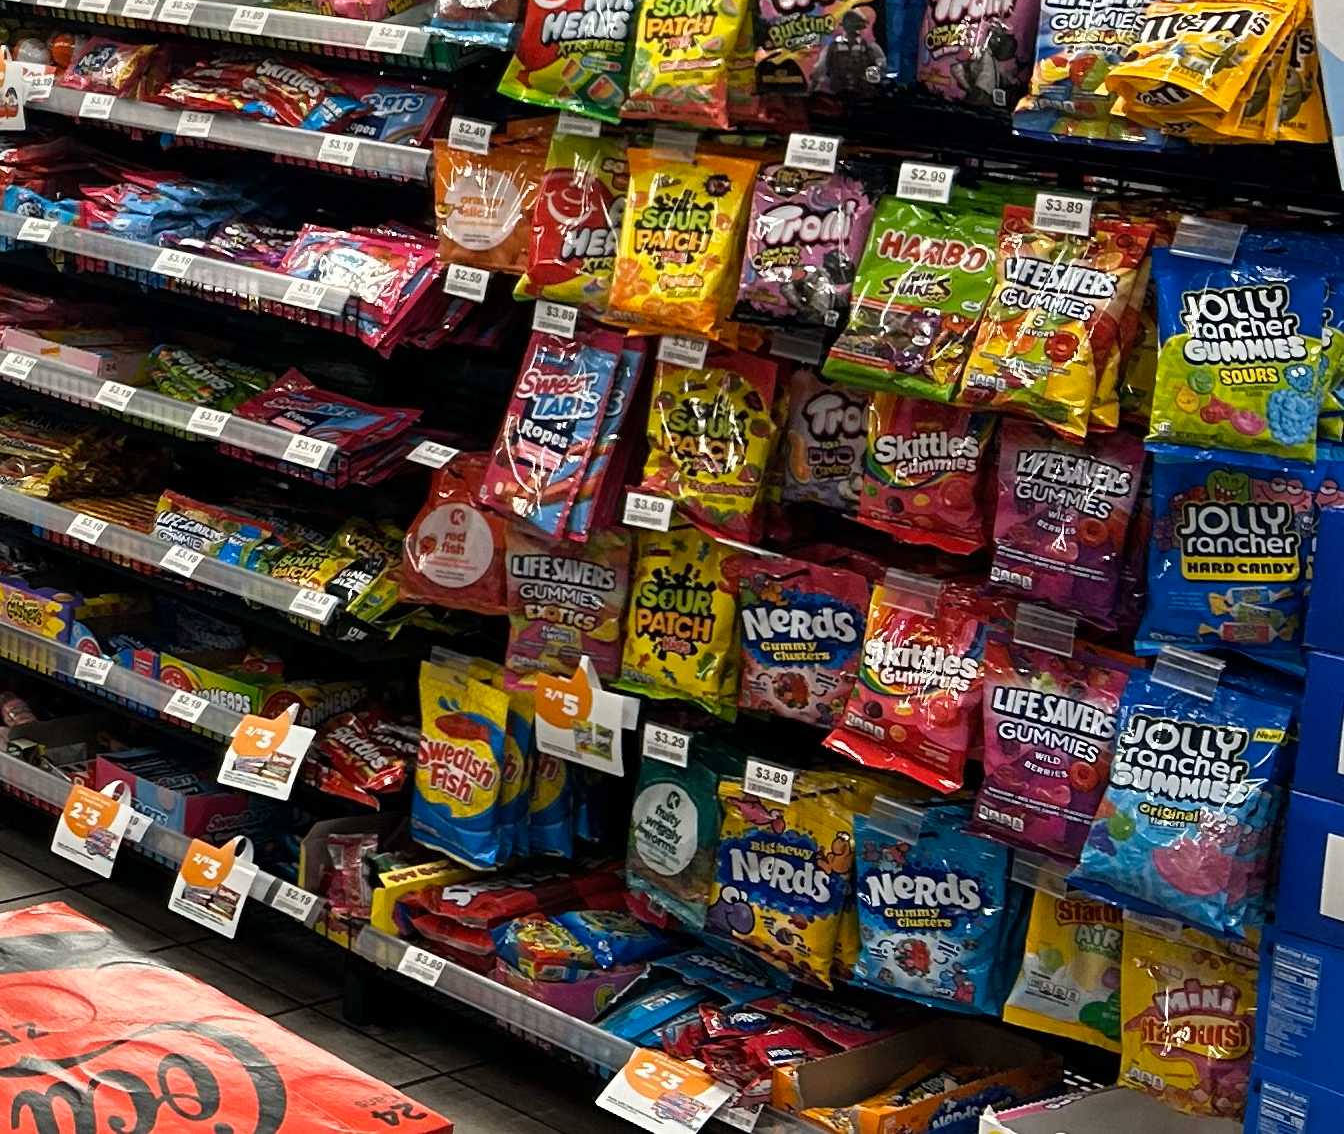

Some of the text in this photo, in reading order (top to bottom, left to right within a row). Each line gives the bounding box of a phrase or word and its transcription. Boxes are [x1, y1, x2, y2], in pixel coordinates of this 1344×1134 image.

[541, 11, 630, 44] HEADS
[645, 16, 718, 40] PATCH
[800, 137, 835, 153] $2.89
[910, 168, 947, 183] $2.99
[1045, 197, 1084, 214] $3.89
[642, 207, 711, 232] SOUR
[758, 200, 859, 244] Trolli
[635, 230, 712, 255] PATCH
[879, 230, 989, 272] HARIBO
[1000, 287, 1094, 321] GUMMIES
[1183, 286, 1287, 320] JOLLY
[1186, 316, 1297, 339] rancher
[1184, 335, 1307, 362] GUMMIES
[1220, 367, 1279, 385] SOURS
[521, 418, 569, 449] Ropes
[874, 433, 980, 464] Skittles
[896, 455, 977, 478] Gummies
[633, 497, 665, 513] $3.69
[1015, 482, 1113, 518] GUMMIES
[1181, 502, 1287, 535] JOLLY
[440, 541, 466, 556] fish
[444, 531, 467, 543] red
[1186, 530, 1298, 556] rancher
[512, 554, 616, 591] LIFESAVERS
[1187, 561, 1296, 575] HARD CANDY
[519, 583, 604, 611] GUMMIES
[640, 580, 712, 614] SOUR
[524, 604, 597, 632] EXOTICS
[636, 608, 714, 643] PATCH
[662, 636, 692, 654] Kids
[760, 641, 818, 653] Gummy
[773, 649, 831, 662] Clusters
[863, 640, 979, 680] Skittles
[175, 695, 202, 710] $2.19
[993, 687, 1117, 739] LIFESAVERS
[653, 731, 686, 750] $3.29
[998, 723, 1100, 764] GUMMIES
[1129, 718, 1247, 758] JOLLY
[1255, 729, 1284, 743] New!
[417, 734, 496, 793] Swedish
[1023, 761, 1069, 779] BERRIES
[1034, 751, 1062, 766] WILD
[1125, 745, 1248, 782] rancher
[430, 766, 474, 805] Fish
[755, 766, 789, 785] $3.89
[1112, 764, 1250, 805] GUMMIES
[655, 800, 683, 829] fruity
[1139, 801, 1200, 823] original
[645, 814, 683, 846] wriggly
[650, 831, 679, 858] worms
[285, 888, 313, 905] $2.19
[883, 906, 942, 920] Gummy
[897, 916, 953, 930] Clusters
[372, 1103, 432, 1128] 24
